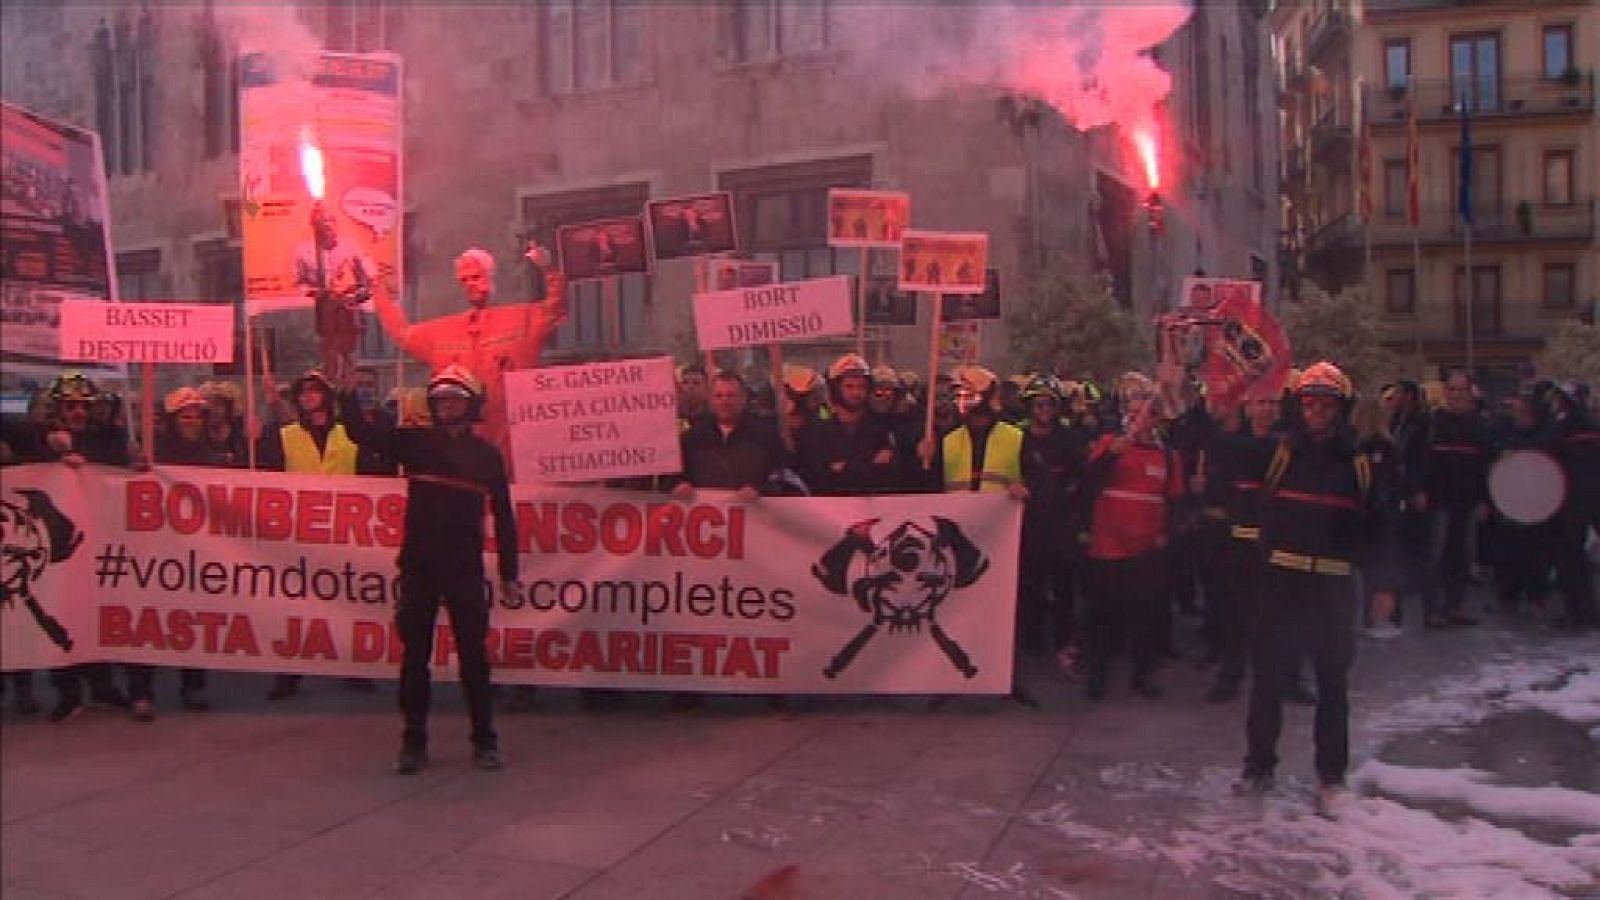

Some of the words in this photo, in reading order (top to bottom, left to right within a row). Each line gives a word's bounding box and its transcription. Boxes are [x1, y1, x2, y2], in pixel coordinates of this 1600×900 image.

[743, 286, 800, 311] BORT
[106, 305, 192, 328] BASSET
[79, 337, 217, 361] DESTITUCIÓ
[535, 373, 560, 390] Sr.
[564, 365, 644, 388] GASPAR
[569, 421, 620, 441] ESTA
[126, 480, 406, 548] BOMBERS
[484, 497, 746, 560] NSORCI
[96, 544, 796, 624] #volemdotascompletes
[98, 605, 262, 657] BASTA
[270, 618, 339, 661] JA
